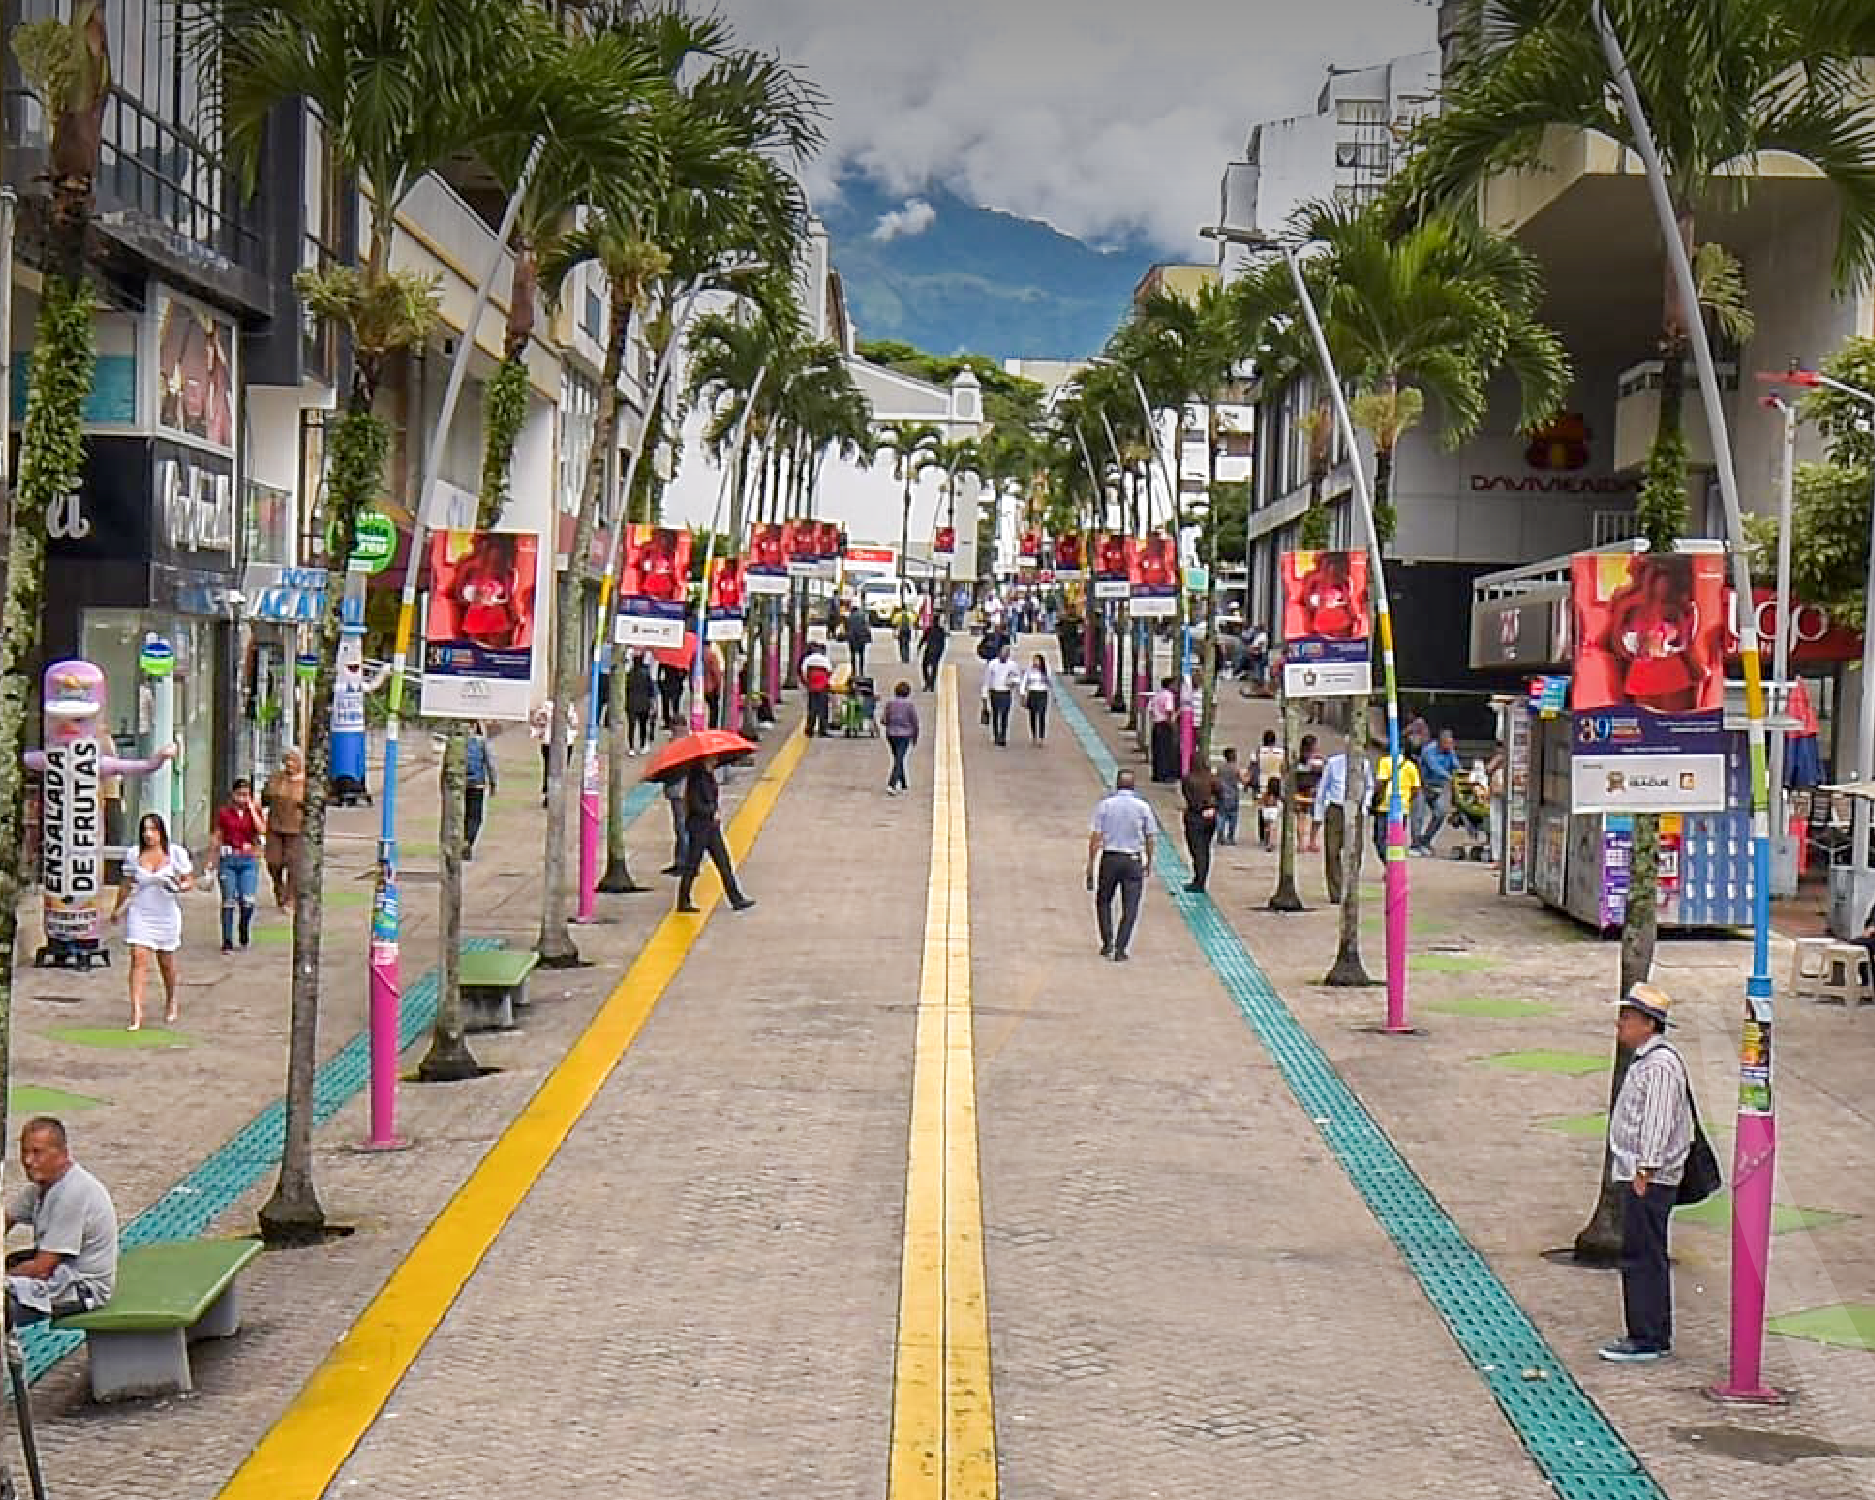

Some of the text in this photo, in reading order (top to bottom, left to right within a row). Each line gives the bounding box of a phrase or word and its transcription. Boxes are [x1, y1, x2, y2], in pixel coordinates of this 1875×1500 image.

[45, 750, 66, 894] ENSALADA
[72, 742, 97, 848] FRUTAS
[72, 858, 95, 893] DE
